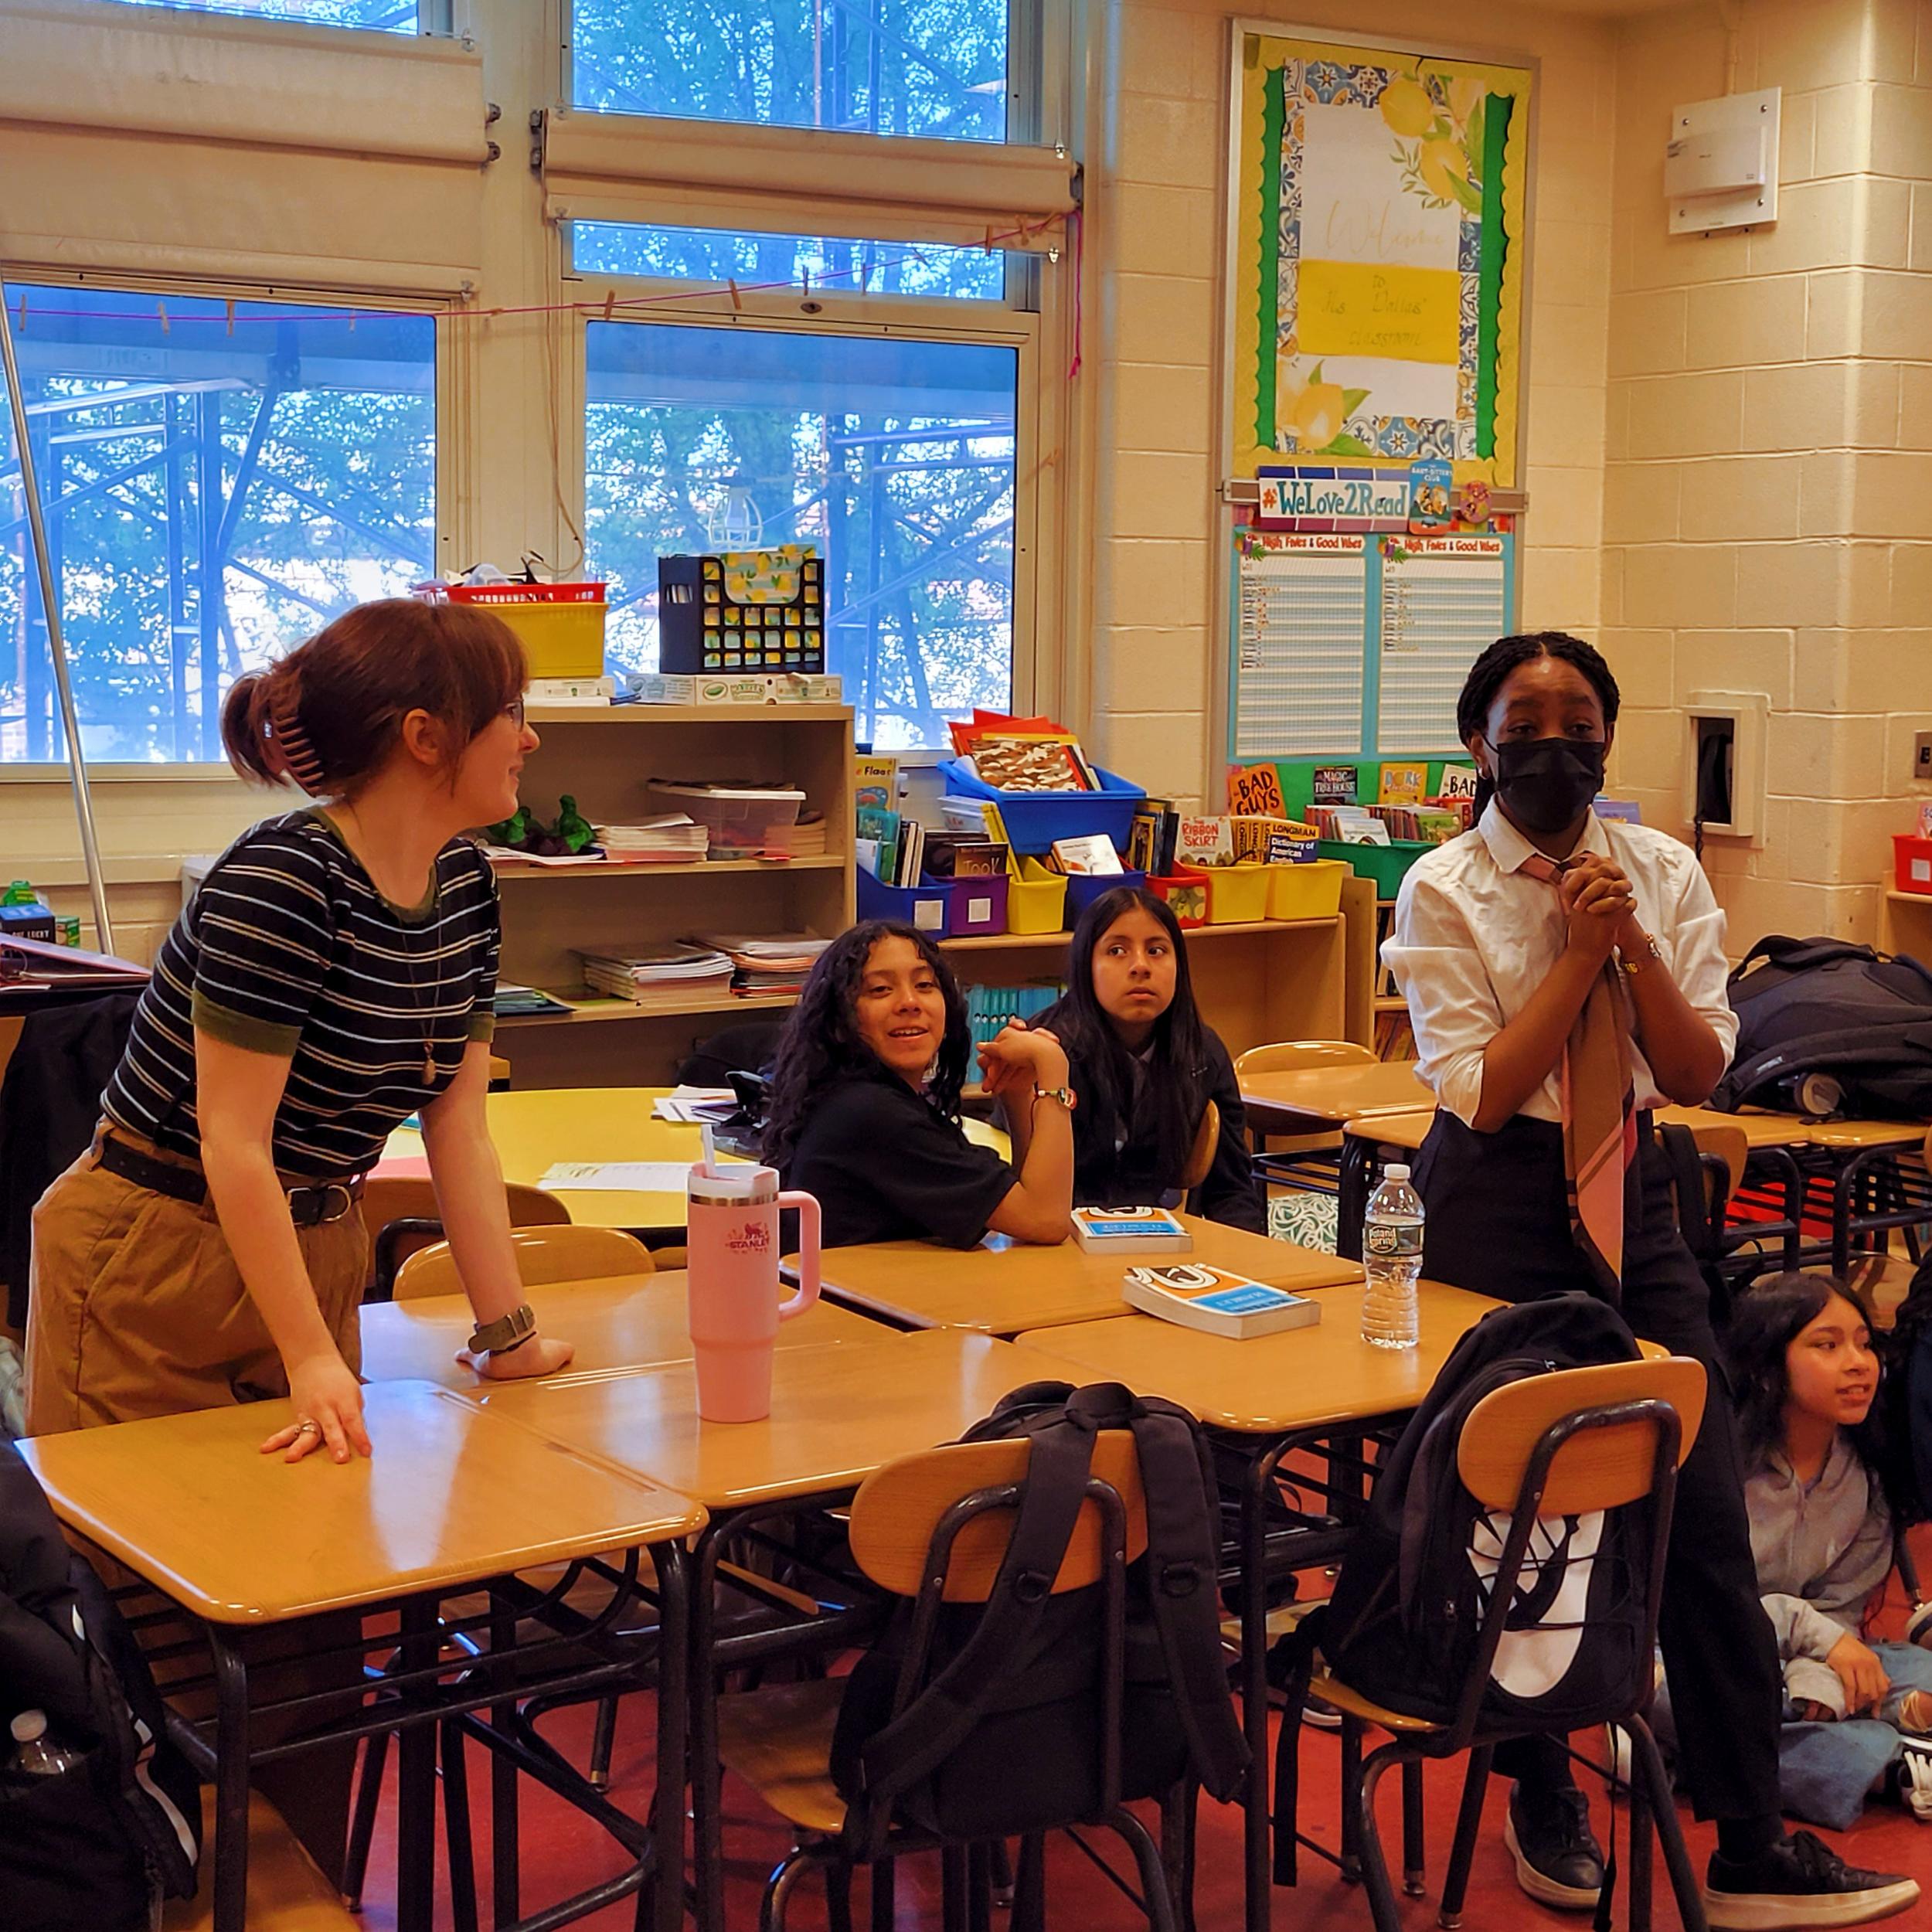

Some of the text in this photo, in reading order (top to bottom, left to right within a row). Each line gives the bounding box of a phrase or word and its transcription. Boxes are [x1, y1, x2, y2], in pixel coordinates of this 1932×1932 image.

[1372, 271, 1386, 289] to
[1262, 480, 1408, 516] #WeLove2Read
[1262, 535, 1283, 549] High
[1285, 536, 1307, 548] Fives
[1316, 536, 1339, 549] Good
[1341, 536, 1362, 549] Vibes
[1404, 538, 1423, 553] High
[1427, 540, 1447, 551] Fives
[1455, 539, 1478, 552] Good
[1479, 540, 1500, 552] Vibes
[1323, 770, 1348, 783] MAGIC
[1237, 771, 1274, 800] BAD
[1332, 781, 1355, 793] HOUSE
[1236, 788, 1280, 816] GUYS
[1182, 822, 1219, 837] RIBBON
[1272, 825, 1316, 838] LONGMAN
[1184, 836, 1219, 847] SKIRT
[1270, 837, 1315, 850] Dictionary of
[1270, 847, 1303, 857] American
[729, 1237, 770, 1249] STANLEY
